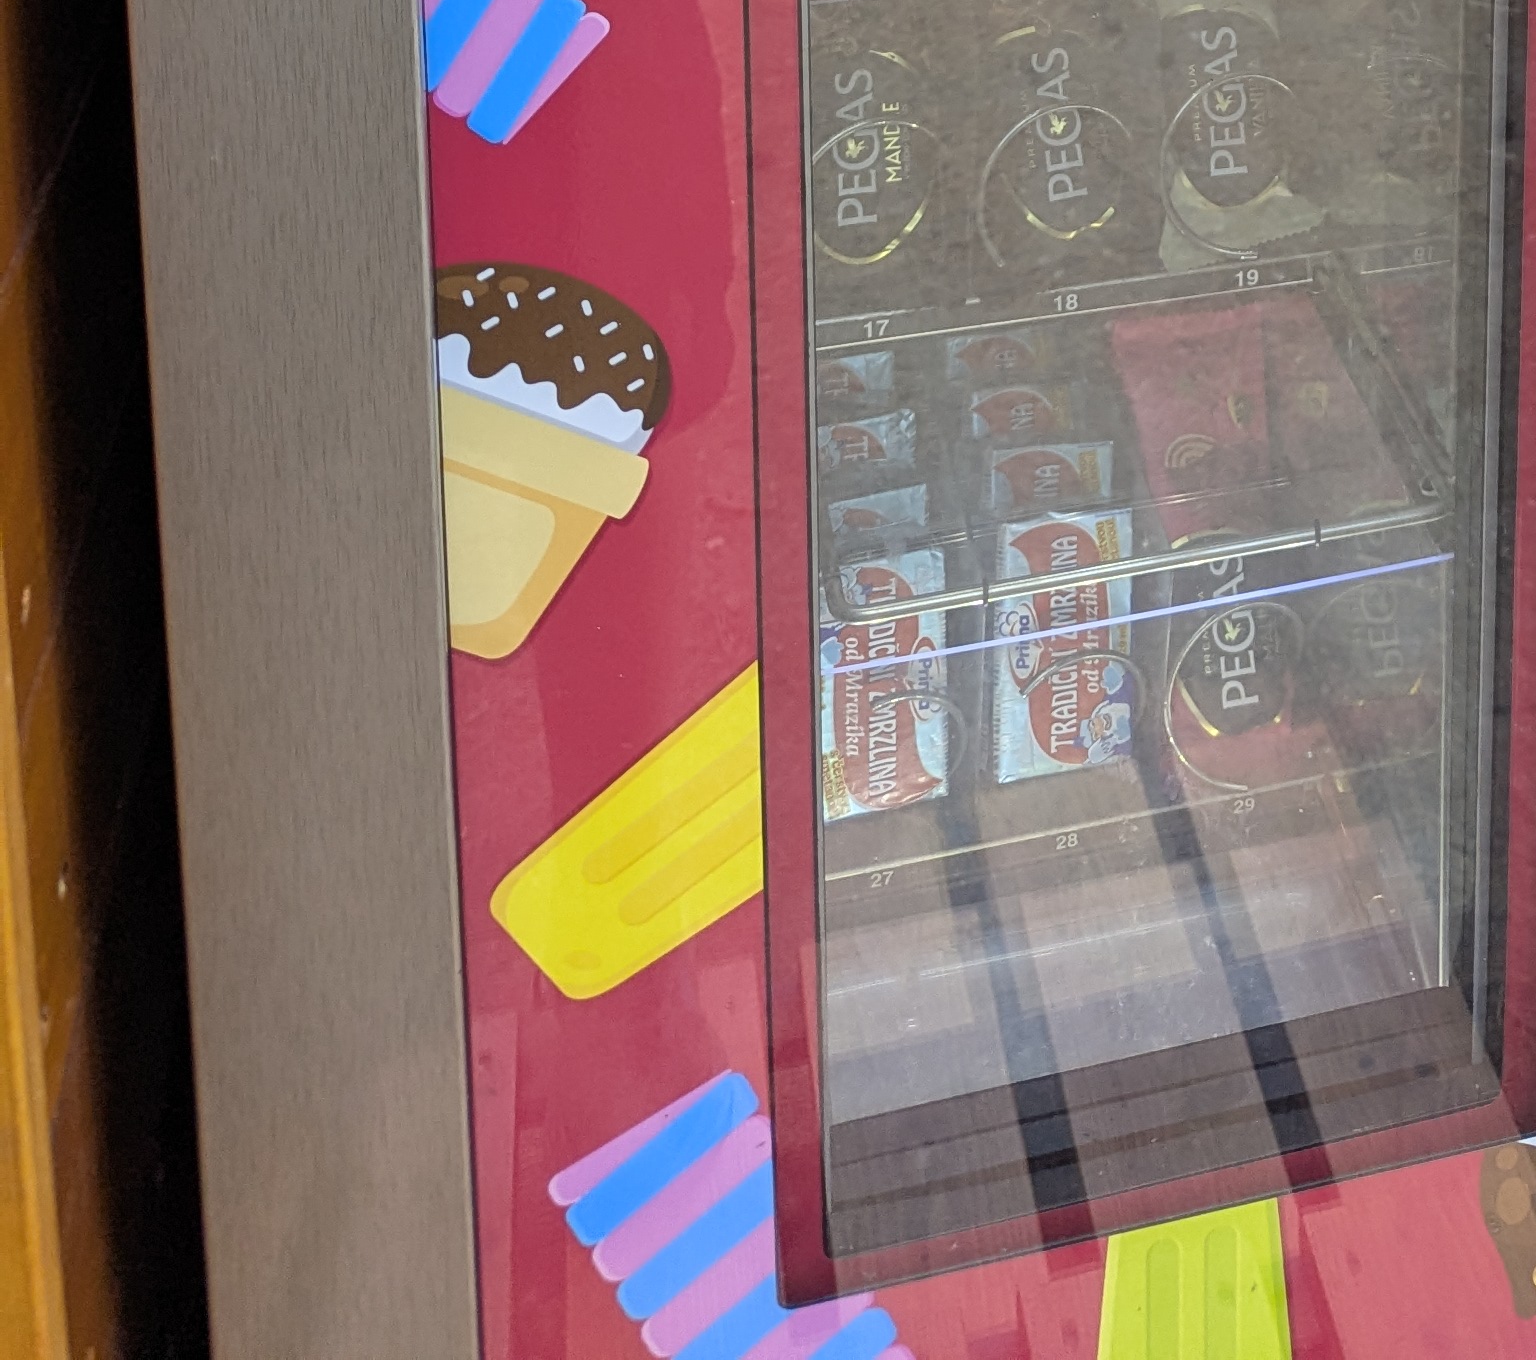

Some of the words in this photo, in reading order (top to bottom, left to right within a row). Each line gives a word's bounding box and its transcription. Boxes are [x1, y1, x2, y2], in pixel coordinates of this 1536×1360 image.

[1201, 25, 1248, 176] PEGAS
[1031, 47, 1088, 202] PEGAS
[832, 68, 880, 227] PEGAS
[883, 101, 902, 183] MANDE
[1235, 269, 1260, 287] 19
[1053, 293, 1079, 311] 18
[864, 319, 890, 337] 17
[1233, 797, 1256, 815] 29
[1055, 832, 1079, 851] 28
[870, 870, 895, 889] 27
